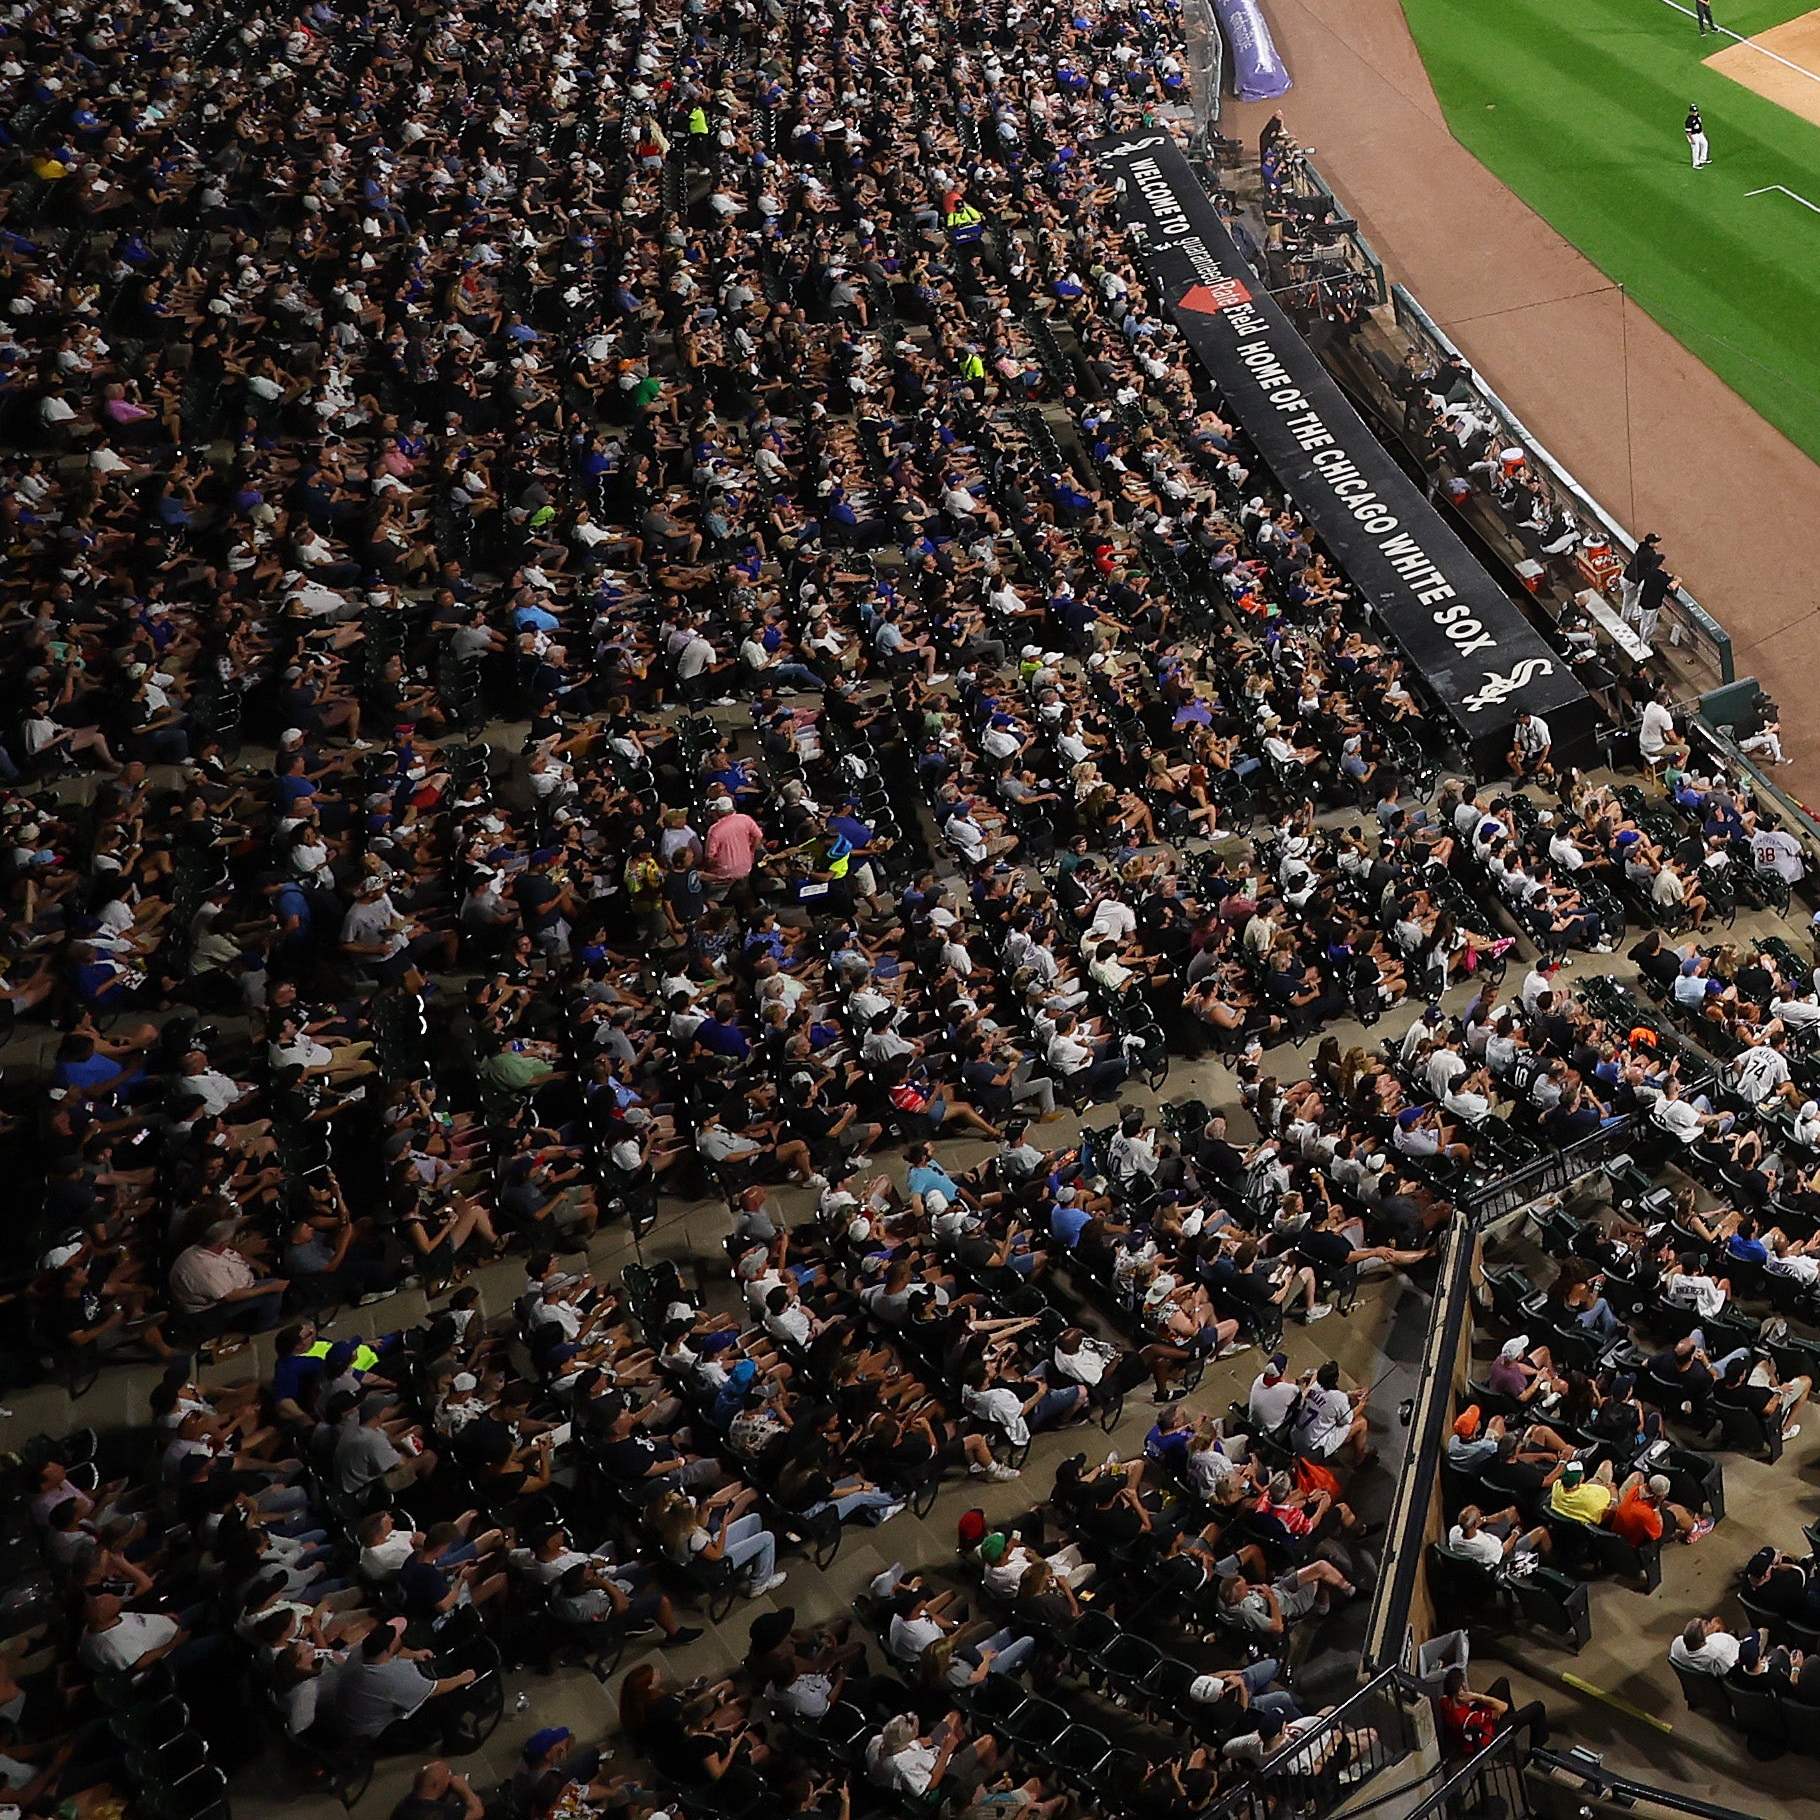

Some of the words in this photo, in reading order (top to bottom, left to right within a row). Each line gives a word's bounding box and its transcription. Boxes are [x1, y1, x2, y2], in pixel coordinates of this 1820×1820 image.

[1129, 157, 1180, 221] WELCOME
[1160, 216, 1191, 236] TO
[1179, 235, 1227, 288] guaranteed
[1209, 276, 1243, 309] Rate
[1223, 302, 1270, 337] Field
[1236, 340, 1285, 390] HOME
[1269, 388, 1308, 414] OF
[1286, 410, 1337, 452] THE
[1311, 448, 1396, 534] CHICAGO
[1377, 531, 1457, 607] WHITE
[1433, 603, 1497, 658] SOX
[1757, 847, 1777, 863] 38
[1514, 1066, 1530, 1088] 10
[1743, 1061, 1767, 1080] 74
